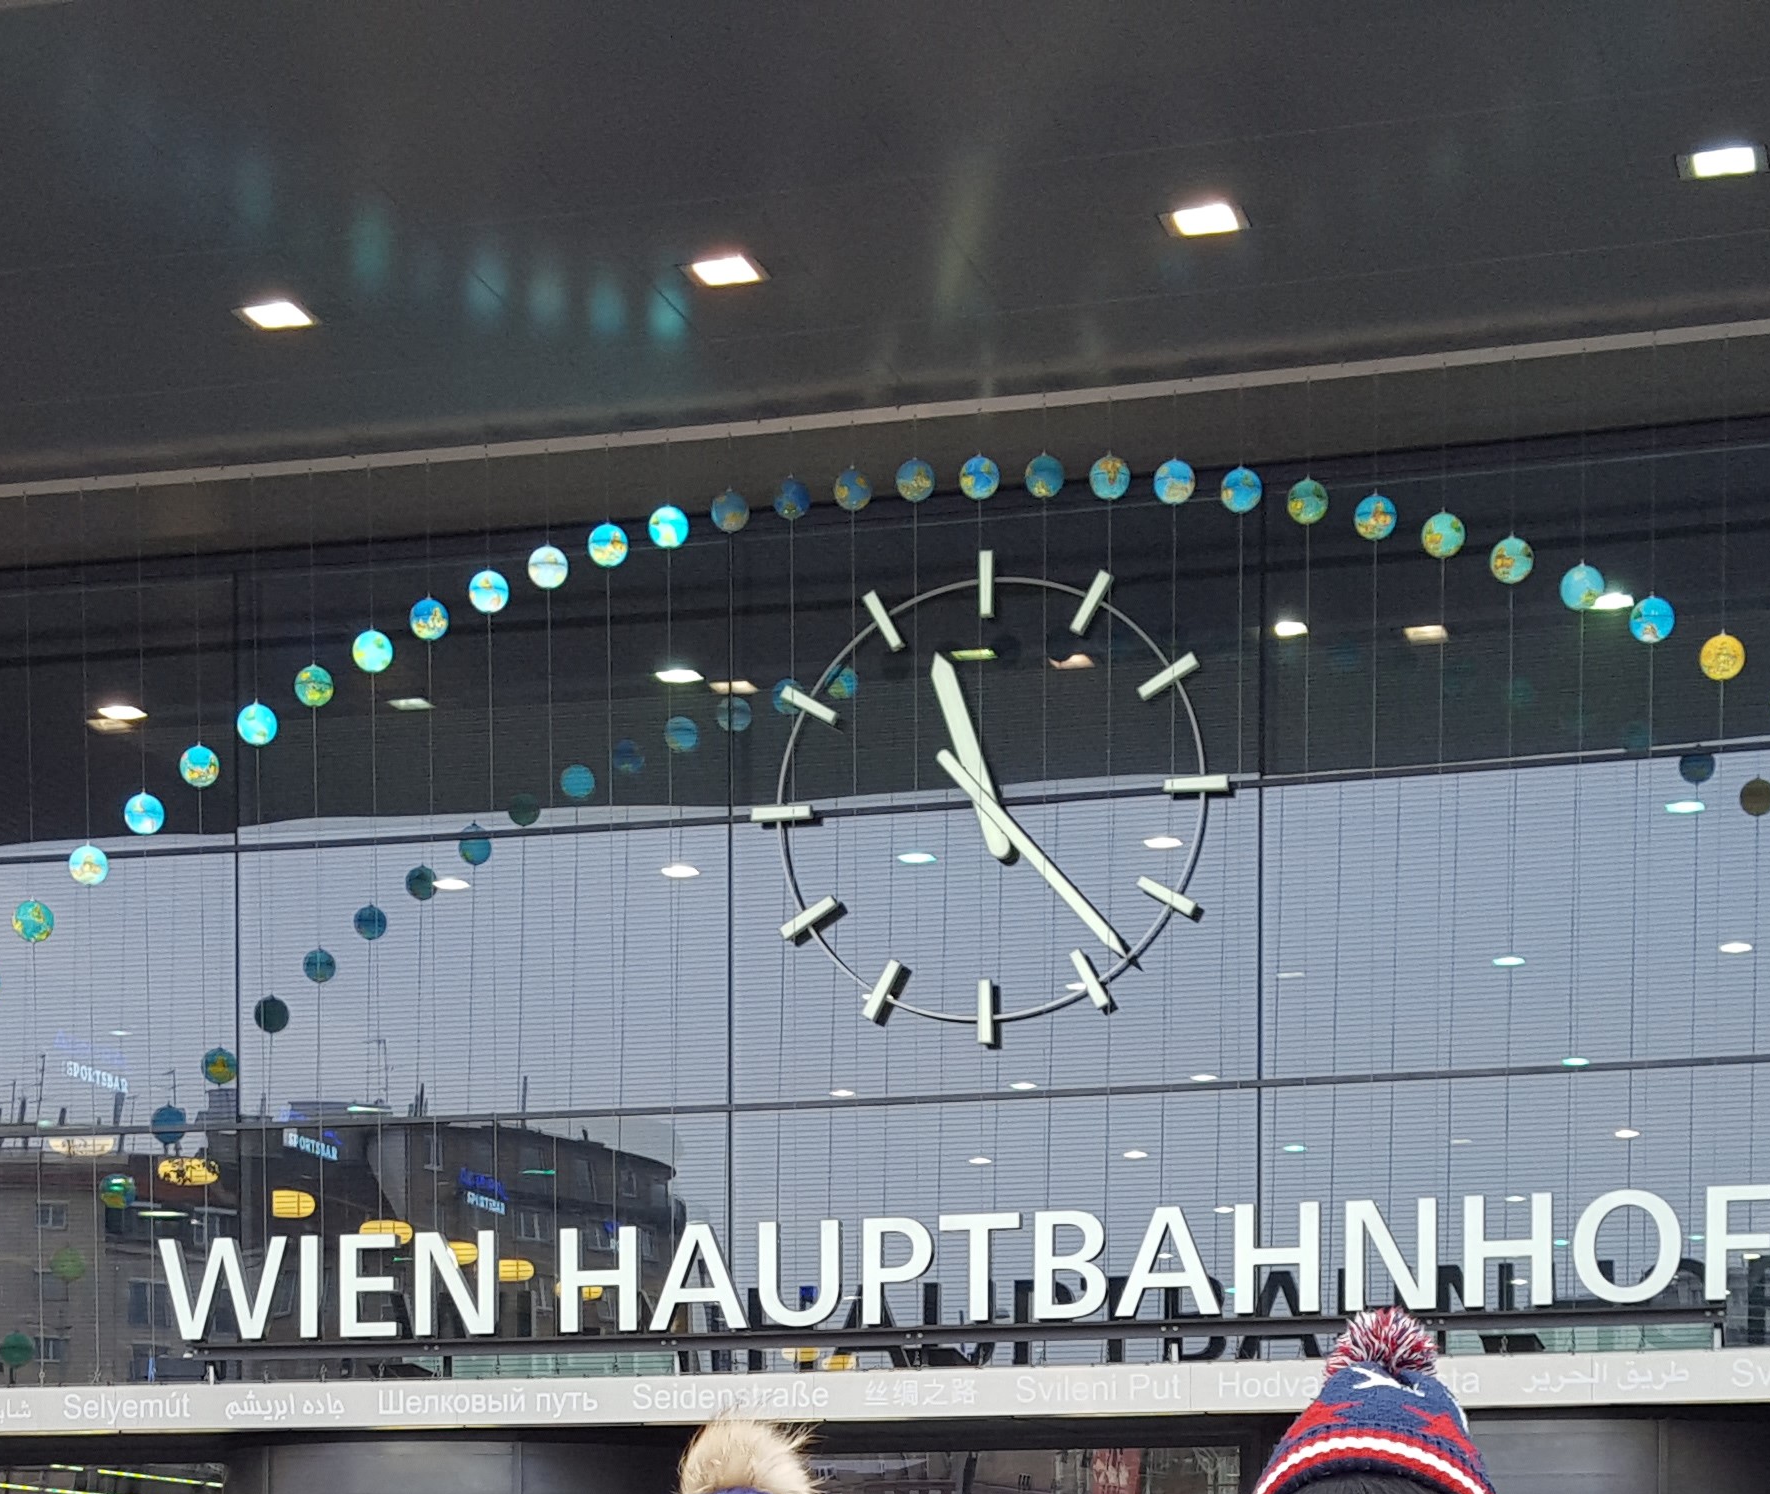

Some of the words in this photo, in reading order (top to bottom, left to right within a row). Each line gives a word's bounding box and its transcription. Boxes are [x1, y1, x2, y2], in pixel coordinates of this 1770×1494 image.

[157, 1229, 495, 1341] WIEN
[377, 1387, 526, 1415] Шелковый
[536, 1391, 599, 1419] путь
[633, 1380, 829, 1410] Seidenstraße
[1016, 1375, 1117, 1403] Svileni
[1129, 1373, 1182, 1401] Put
[63, 1391, 191, 1425] Selyemút
